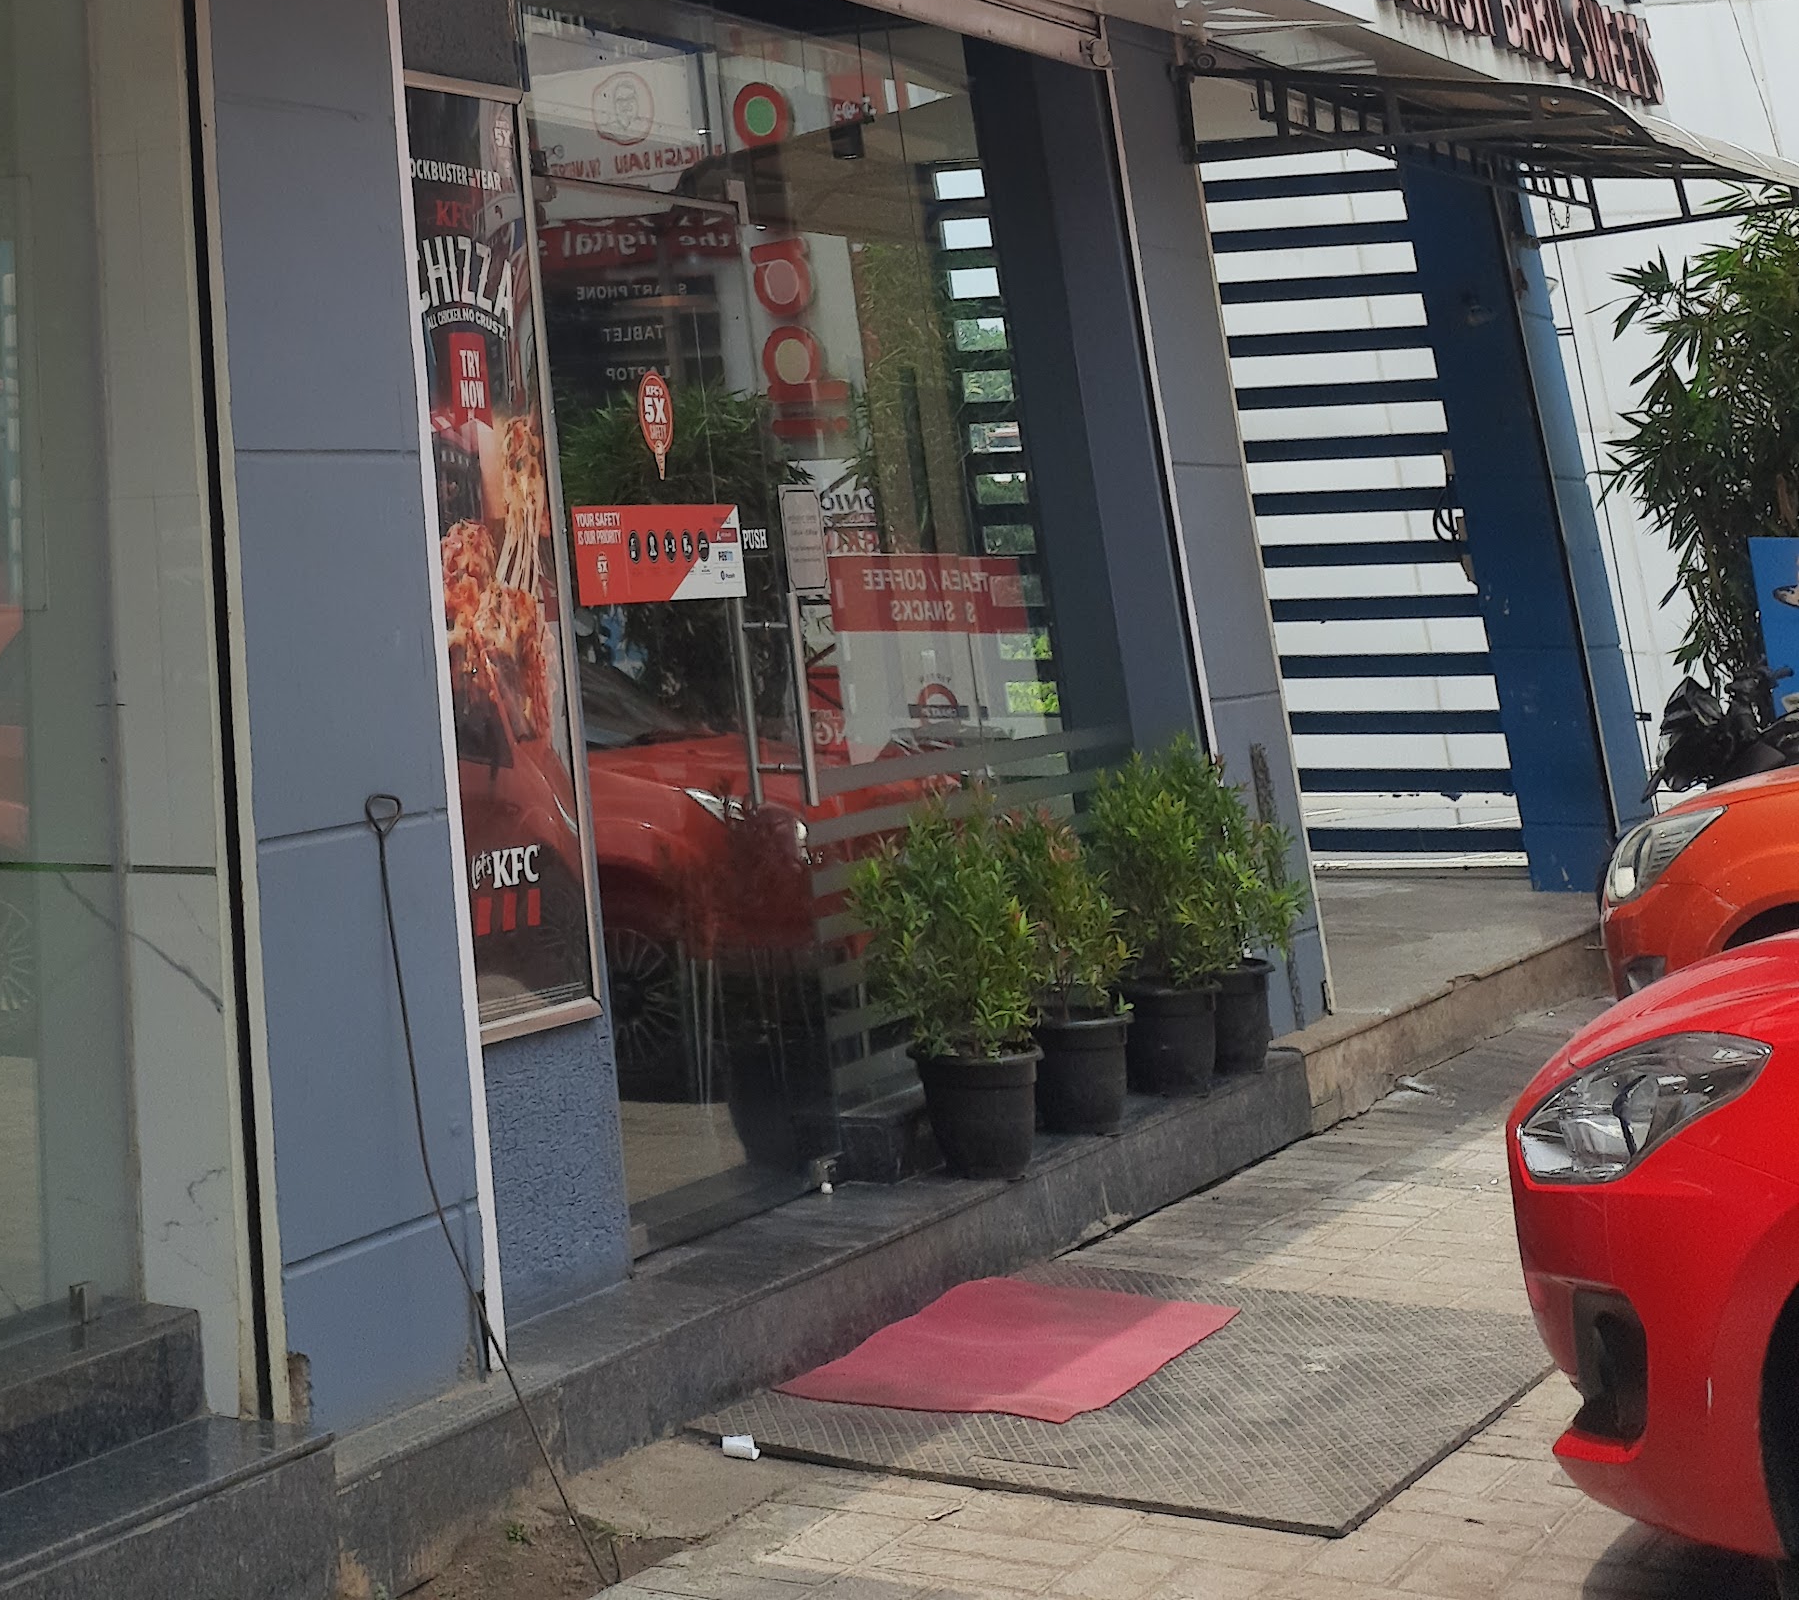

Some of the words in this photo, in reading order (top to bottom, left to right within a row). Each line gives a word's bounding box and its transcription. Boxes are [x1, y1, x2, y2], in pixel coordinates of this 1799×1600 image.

[474, 169, 502, 192] YEAR
[436, 199, 473, 230] KFC
[462, 307, 475, 322] NO
[459, 349, 481, 379] TRY
[460, 380, 485, 409] NOW
[643, 397, 668, 424] 5X
[575, 513, 595, 528] YOUR
[595, 512, 622, 527] SAFETY
[742, 528, 768, 550] PUSH
[491, 844, 541, 890] KFC
